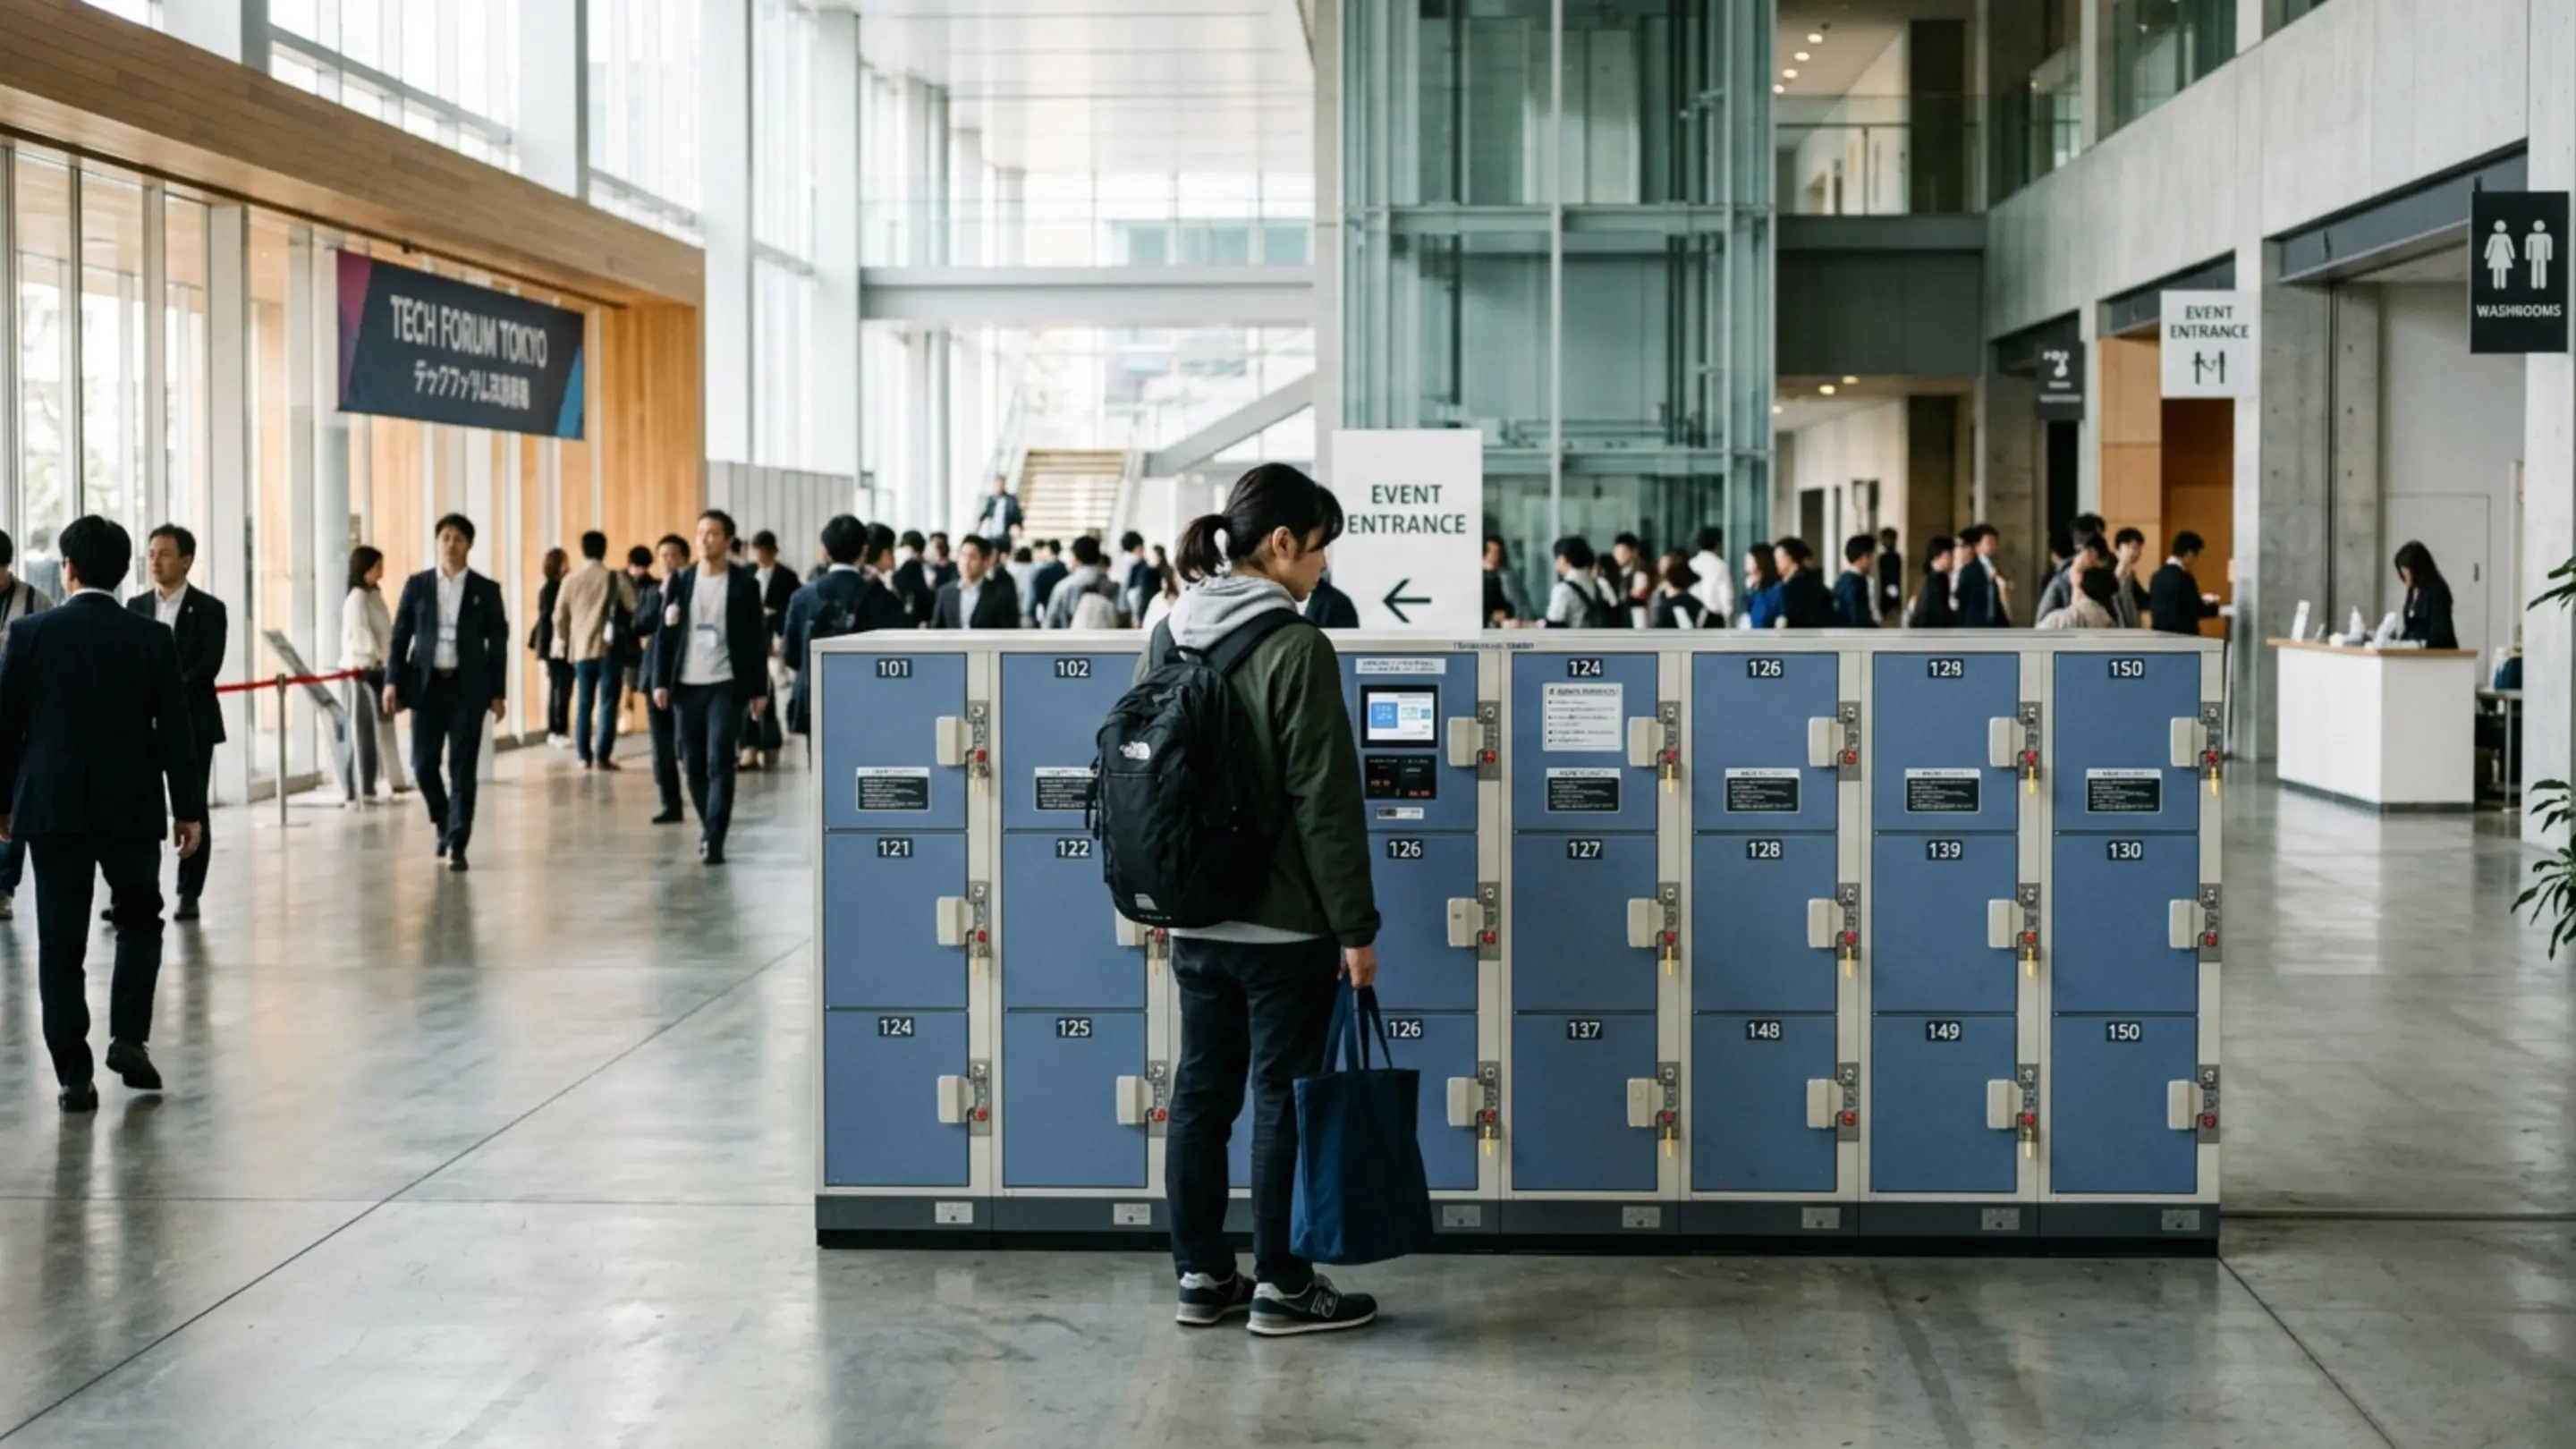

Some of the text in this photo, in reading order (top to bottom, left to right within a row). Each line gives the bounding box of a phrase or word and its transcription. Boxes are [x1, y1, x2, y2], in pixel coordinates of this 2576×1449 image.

[2185, 305, 2233, 319] EVENT
[390, 294, 548, 369] TECH FORUM TOKYO
[2170, 324, 2250, 339] ENTRANCE
[1371, 484, 1443, 504] EVENT
[1347, 513, 1467, 534] ENTRANCE
[879, 660, 910, 676] 101
[1057, 660, 1089, 676] 102
[1570, 660, 1601, 675] 124
[1750, 660, 1782, 676] 126
[879, 841, 910, 856] 121
[1057, 841, 1089, 857] 122
[1389, 841, 1421, 857] 126
[1570, 842, 1602, 858] 127
[1750, 842, 1781, 858] 128
[1929, 842, 1961, 858] 139
[2110, 842, 2141, 859] 130
[880, 1019, 912, 1035] 124
[1058, 1021, 1090, 1037] 125
[1390, 1021, 1421, 1038] 126
[1569, 1021, 1600, 1038] 137
[1749, 1022, 1780, 1038] 148
[1929, 1023, 1960, 1039] 149
[2109, 1023, 2140, 1040] 150
